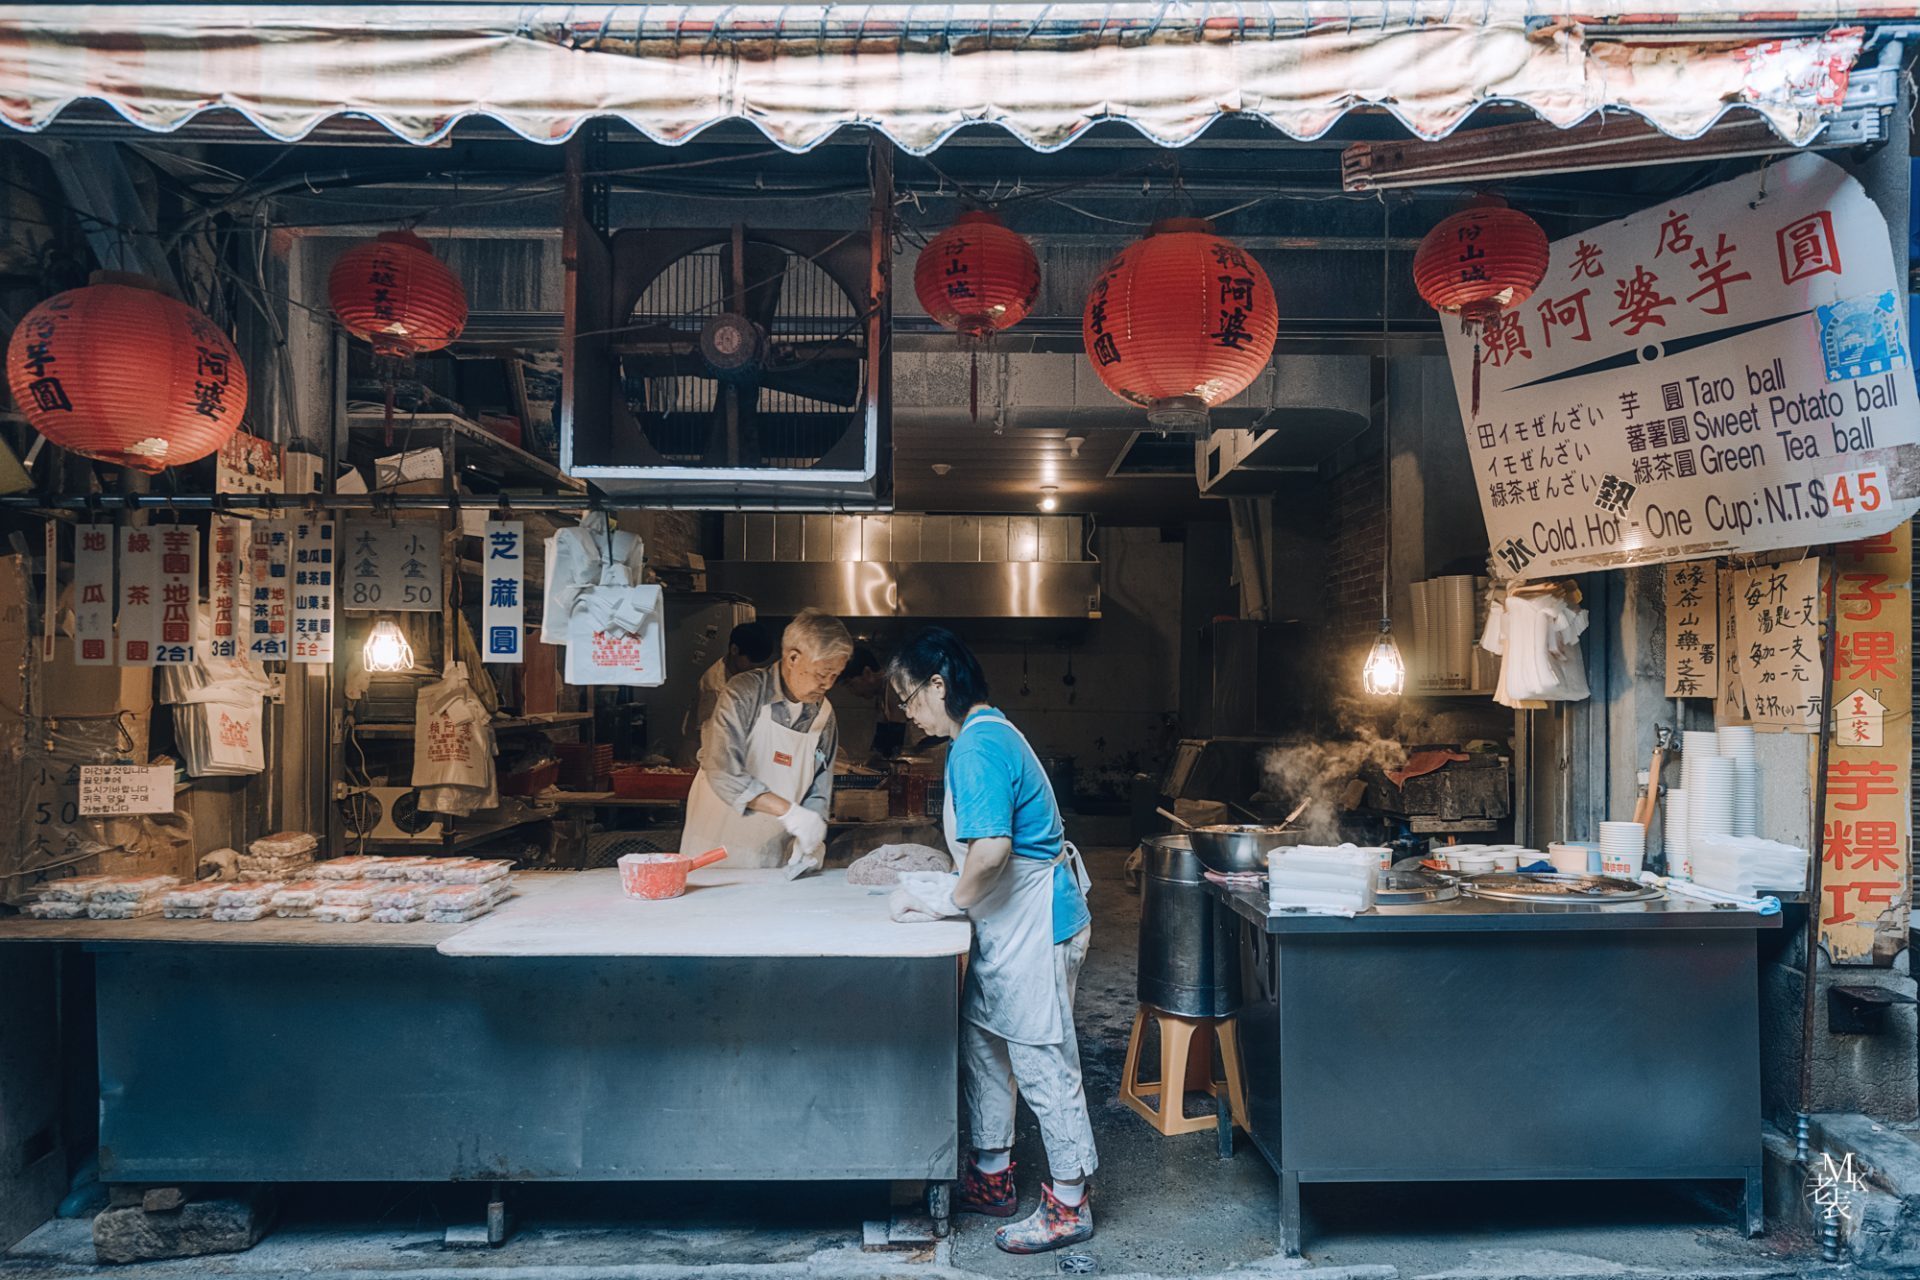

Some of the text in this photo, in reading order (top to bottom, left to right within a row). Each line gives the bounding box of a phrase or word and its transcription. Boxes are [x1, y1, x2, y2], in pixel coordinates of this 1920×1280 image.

[1458, 214, 1492, 282] 份山城
[1569, 209, 1694, 282] 老店
[1686, 357, 1786, 406] Taro ball
[1477, 403, 1604, 449] 田イモぜんざい
[1694, 373, 1898, 441] Sweet Potato ball
[1488, 439, 1591, 478] イモぜんざい
[1700, 416, 1875, 475] Green Tea ball
[1632, 448, 1697, 486] 綠茶圓
[1595, 474, 1637, 518] 熱
[1646, 503, 1692, 539] One
[1497, 536, 1536, 574] 冰
[82, 531, 106, 659] 地瓜圓
[126, 532, 150, 661] 綠茶圓
[353, 582, 381, 604] 80
[402, 584, 432, 604] 50
[1744, 573, 1789, 611] 每杯
[1757, 595, 1816, 635] 湯匙一支
[156, 645, 194, 662] 2合1
[211, 640, 235, 657] 3合1
[251, 639, 287, 653] 4合1
[296, 642, 330, 657] 五合一
[1759, 664, 1809, 684] 加一元
[1851, 695, 1871, 742] 王家
[35, 802, 77, 824] 50
